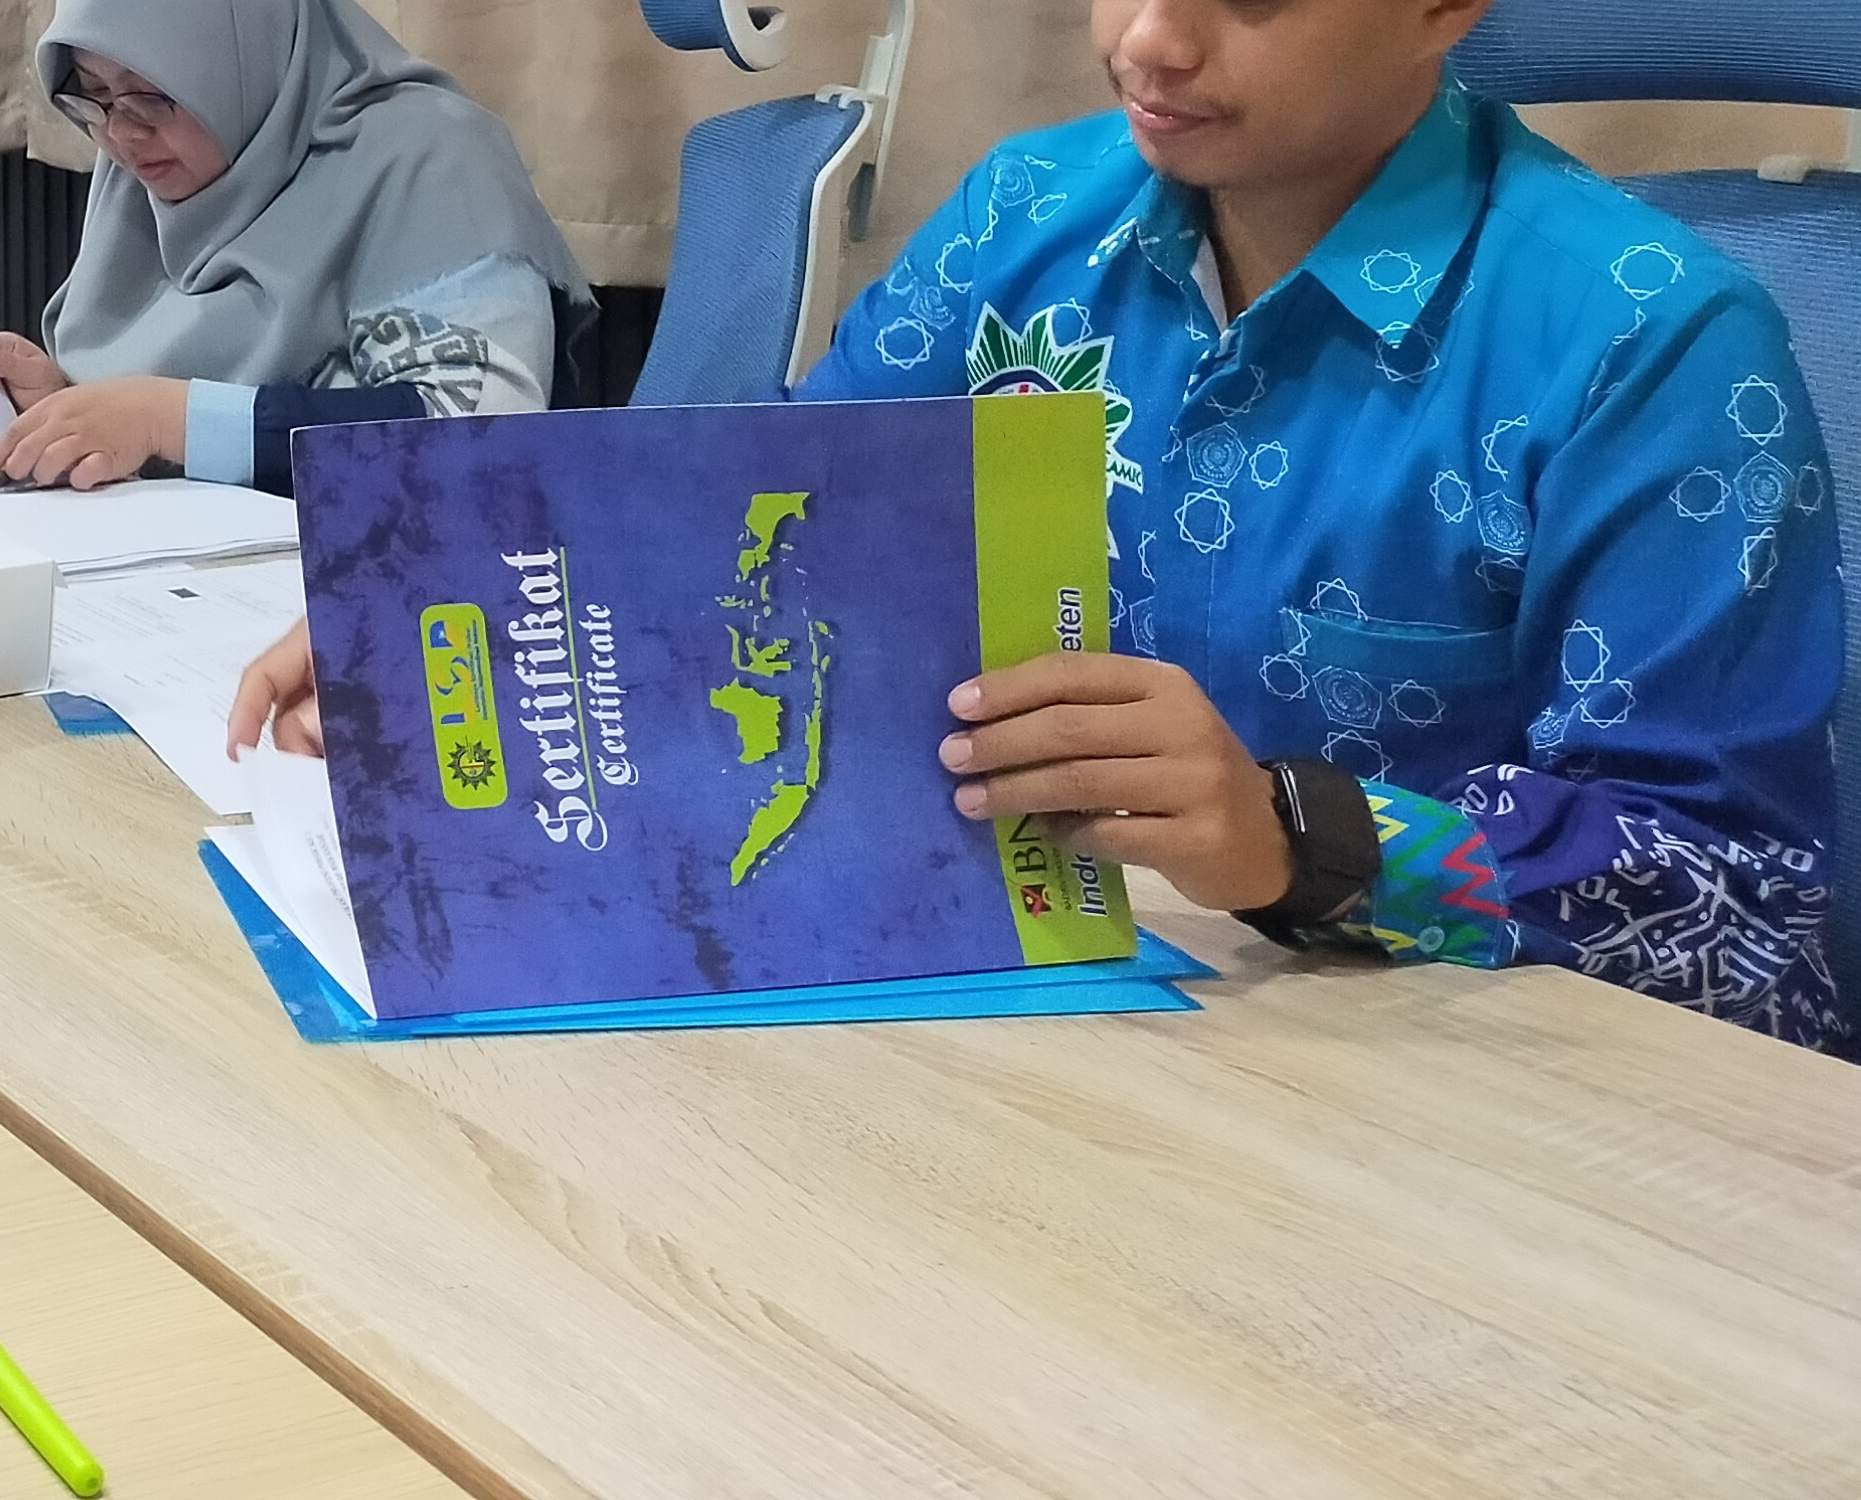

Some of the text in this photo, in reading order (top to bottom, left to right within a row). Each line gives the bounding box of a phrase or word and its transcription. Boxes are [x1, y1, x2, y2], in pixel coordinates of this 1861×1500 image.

[1106, 460, 1141, 487] AMIC
[501, 548, 608, 851] Sertifikat
[579, 604, 639, 786] Certificate
[1055, 588, 1108, 917] Ind eten
[1008, 812, 1047, 874] BN
